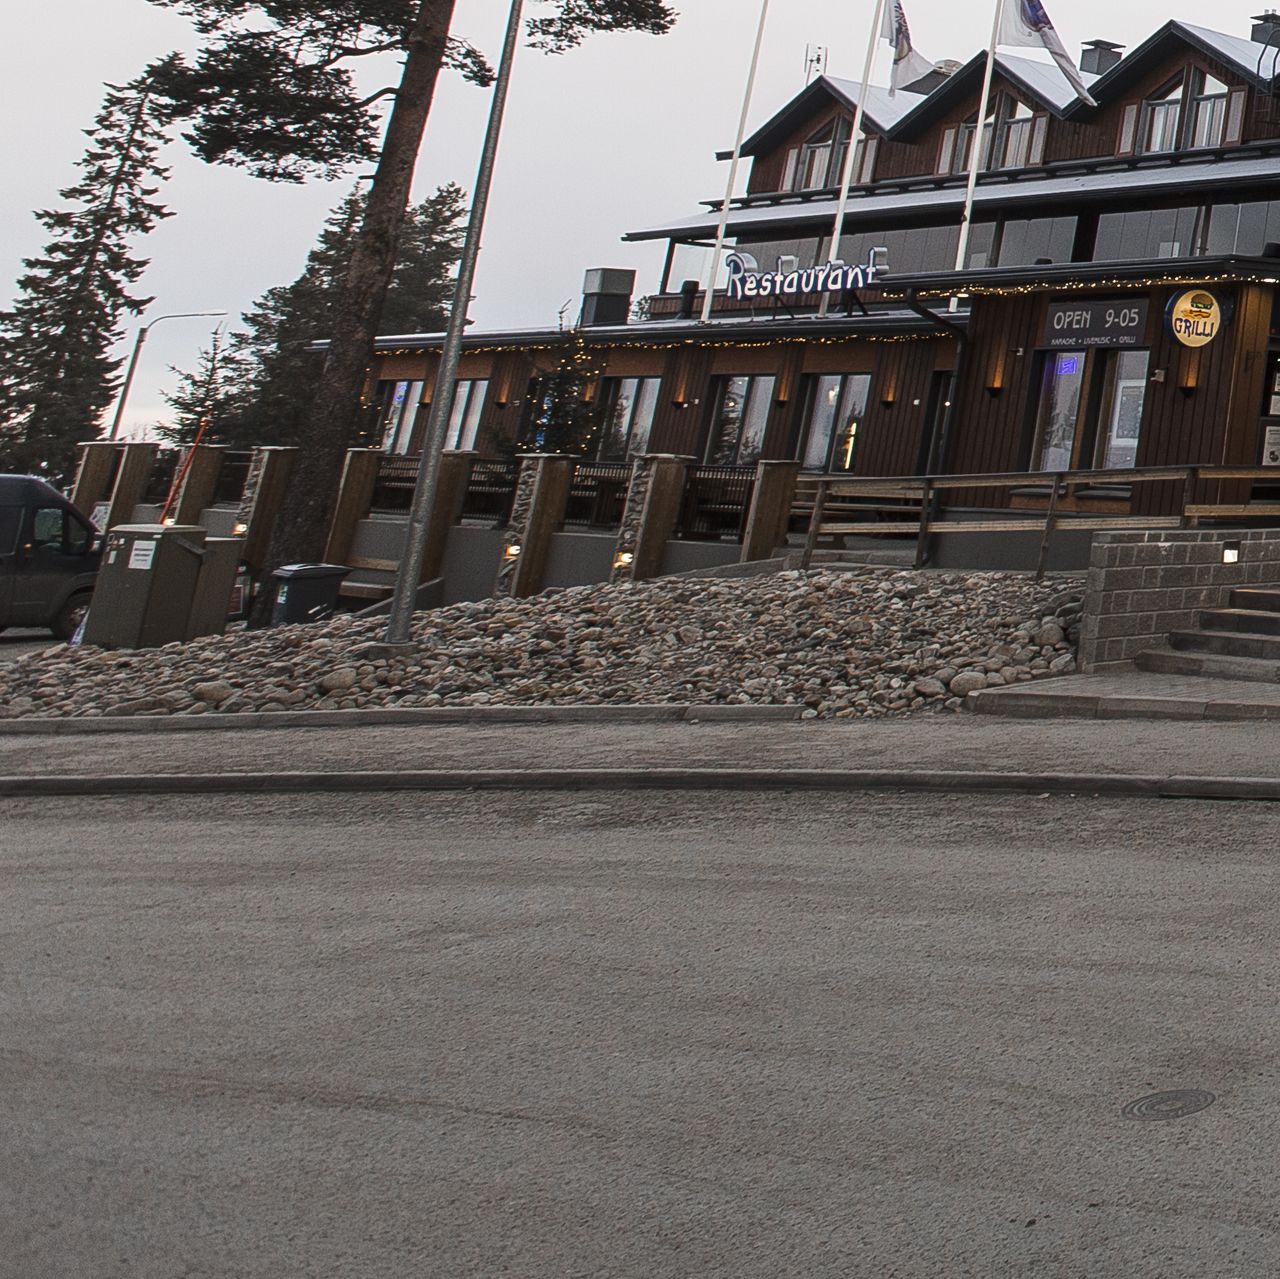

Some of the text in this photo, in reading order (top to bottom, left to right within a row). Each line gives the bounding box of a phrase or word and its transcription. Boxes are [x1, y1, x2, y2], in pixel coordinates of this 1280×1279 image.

[726, 247, 883, 300] Restaurant
[1053, 308, 1140, 329] OPEN 9-05
[1173, 317, 1215, 339] GRILLI
[1051, 335, 1136, 345] KARAOKE LIVEMUSIC GRILLI
